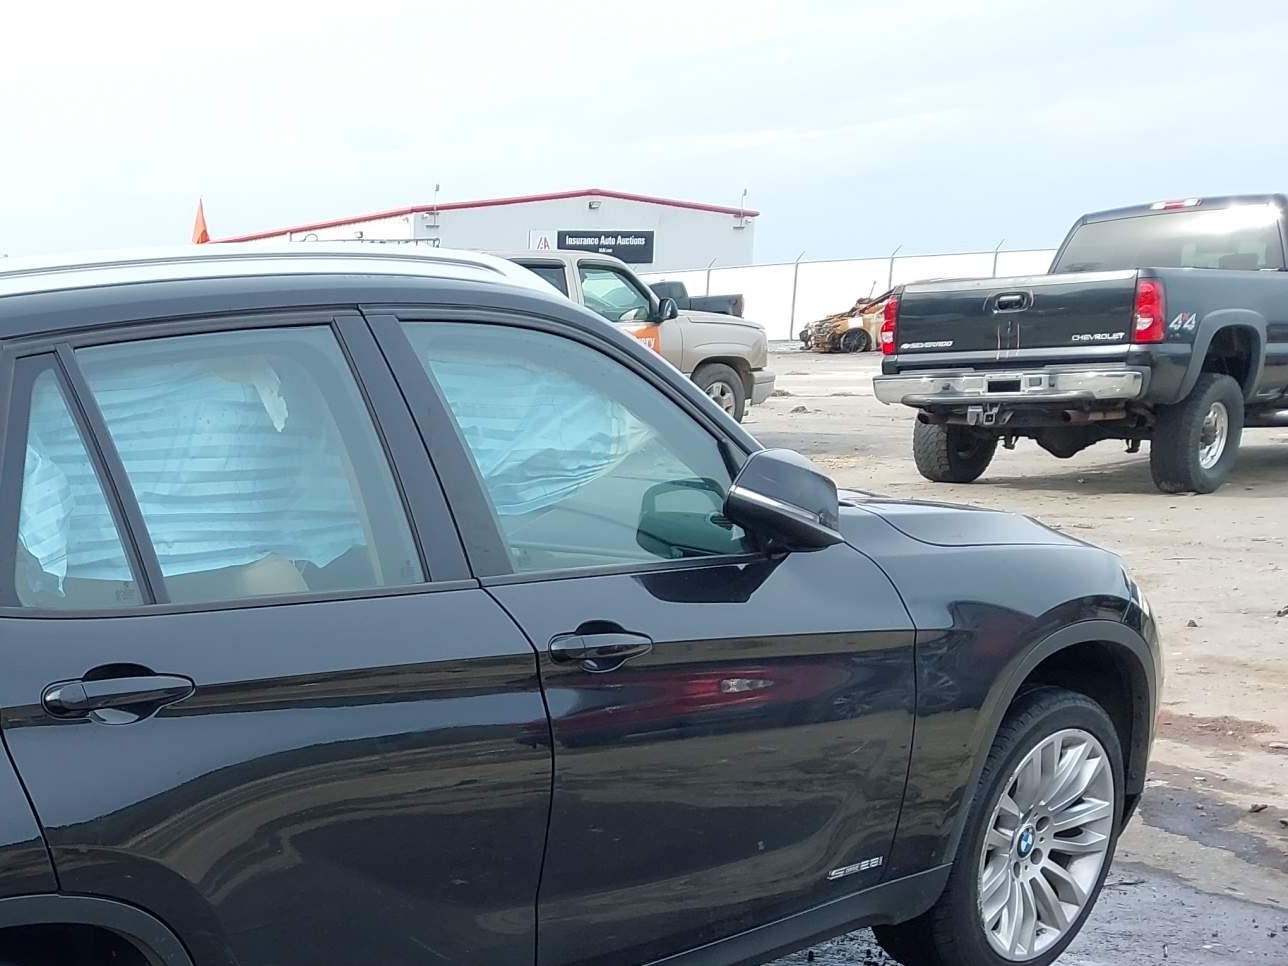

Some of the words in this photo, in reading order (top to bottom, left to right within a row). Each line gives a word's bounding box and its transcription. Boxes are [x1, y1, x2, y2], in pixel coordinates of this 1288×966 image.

[566, 235, 599, 245] Insurance
[600, 235, 616, 245] Auto
[617, 235, 646, 245] Auctions
[1072, 332, 1125, 341] CHEVROLET
